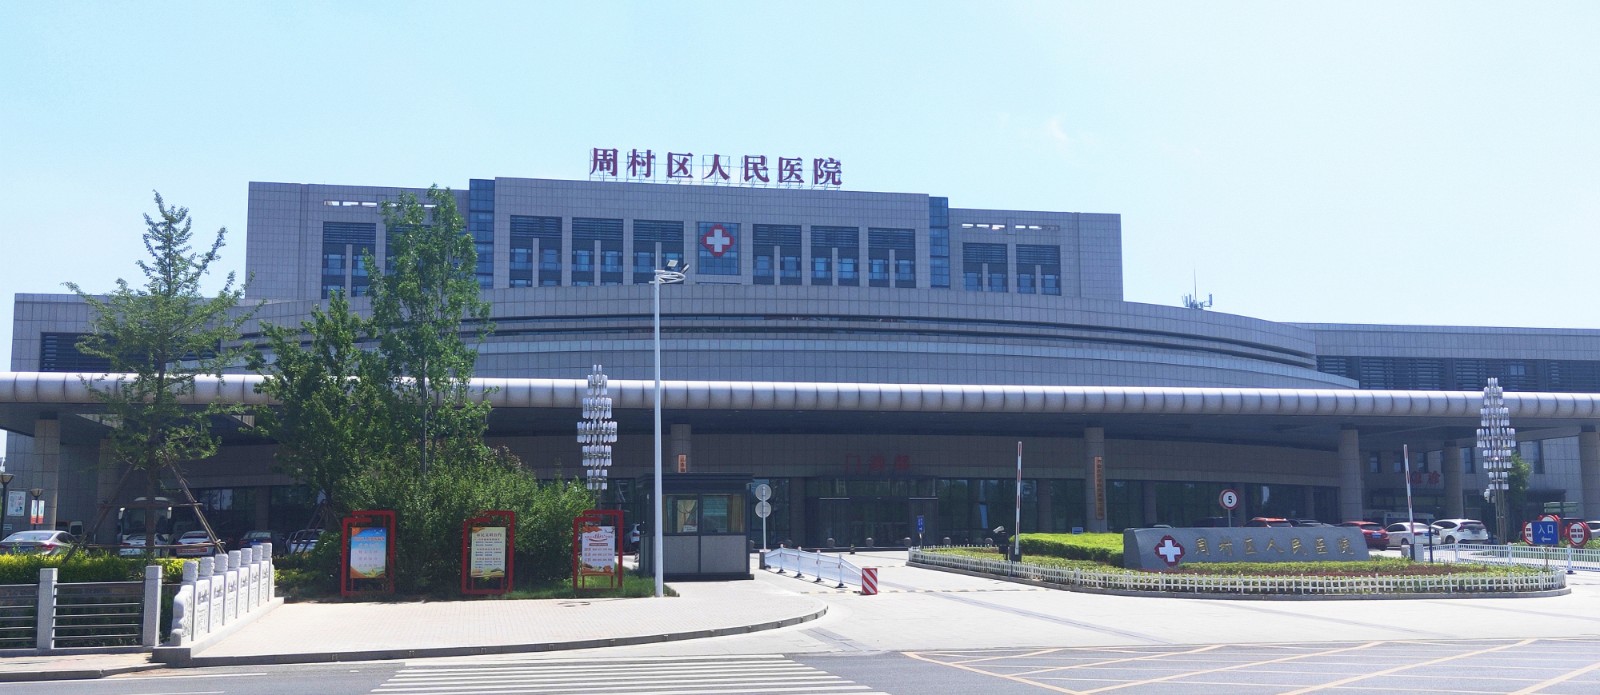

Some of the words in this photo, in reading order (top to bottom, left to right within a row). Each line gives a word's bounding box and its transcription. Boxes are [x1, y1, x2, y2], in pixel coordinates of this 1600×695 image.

[590, 148, 842, 184] 周村区人民医院
[1228, 495, 1233, 503] 5
[1538, 524, 1554, 534] 入口
[1195, 536, 1355, 556] 周村区人民医院
